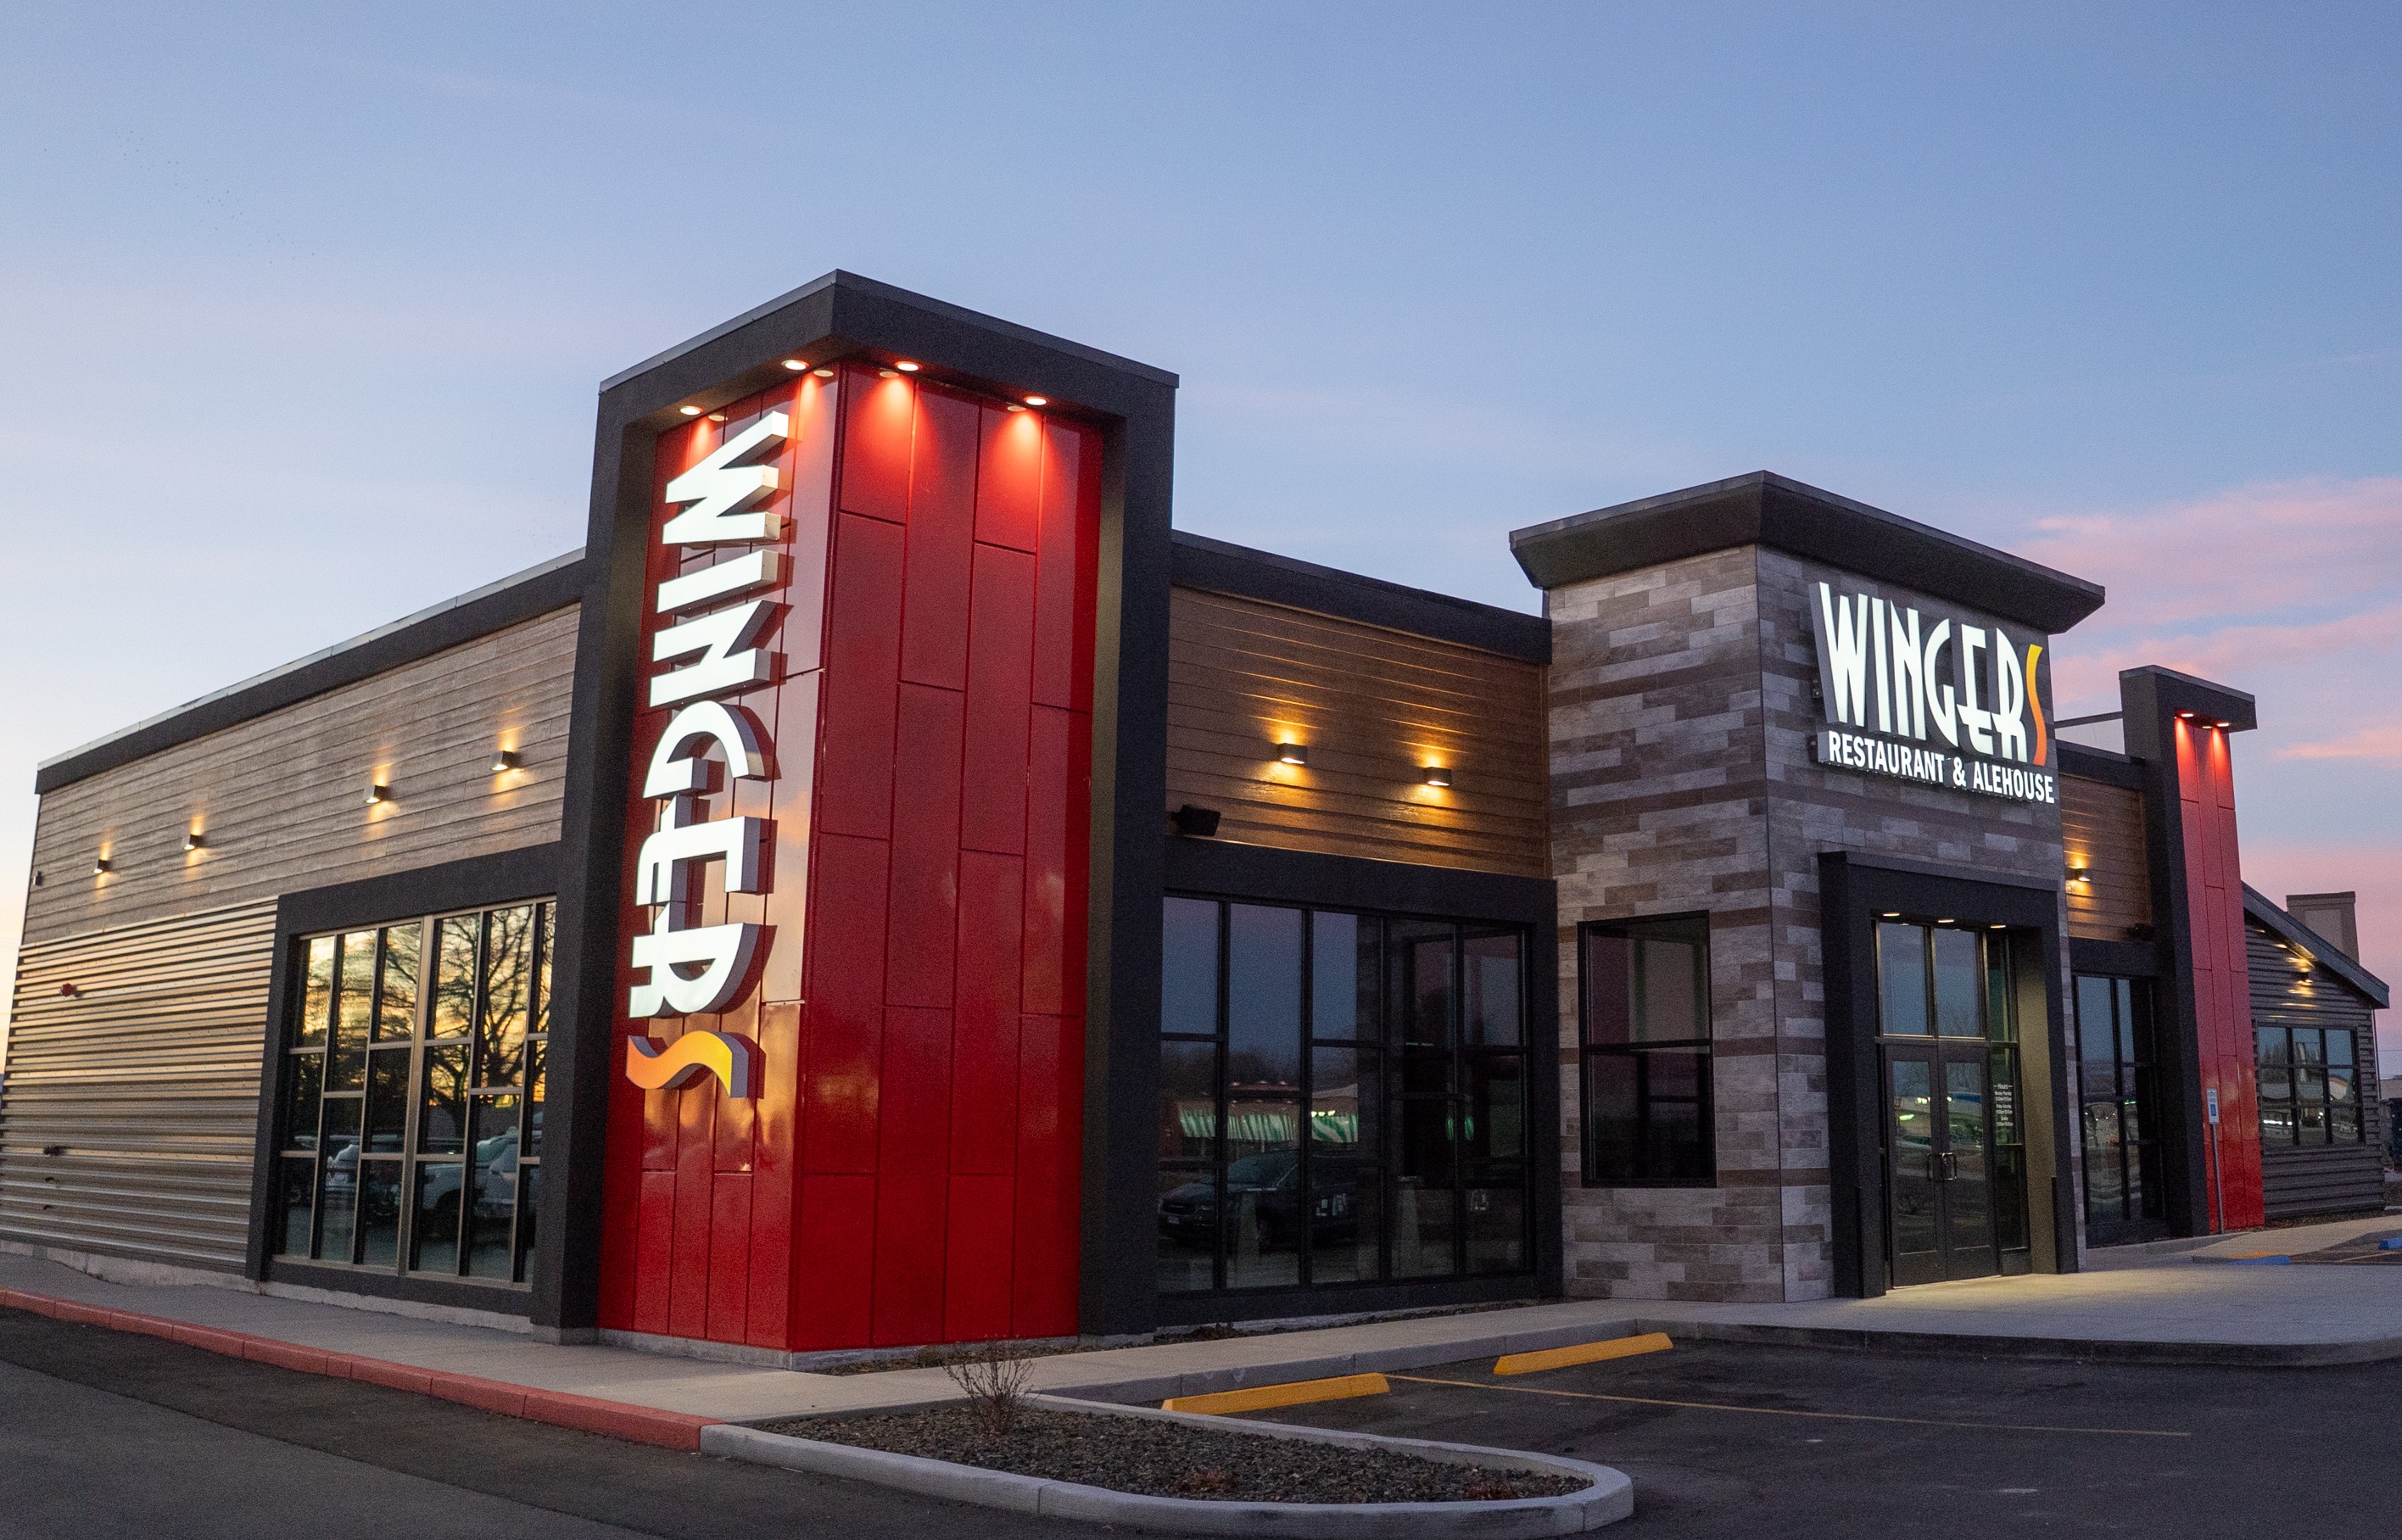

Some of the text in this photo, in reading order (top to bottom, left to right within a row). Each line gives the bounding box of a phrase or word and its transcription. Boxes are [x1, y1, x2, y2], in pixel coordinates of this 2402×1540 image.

[626, 410, 782, 1098] WINGERS
[1818, 581, 2047, 767] WINGERS
[1828, 730, 2055, 804] RESTAURANT & ALEHOUSE
